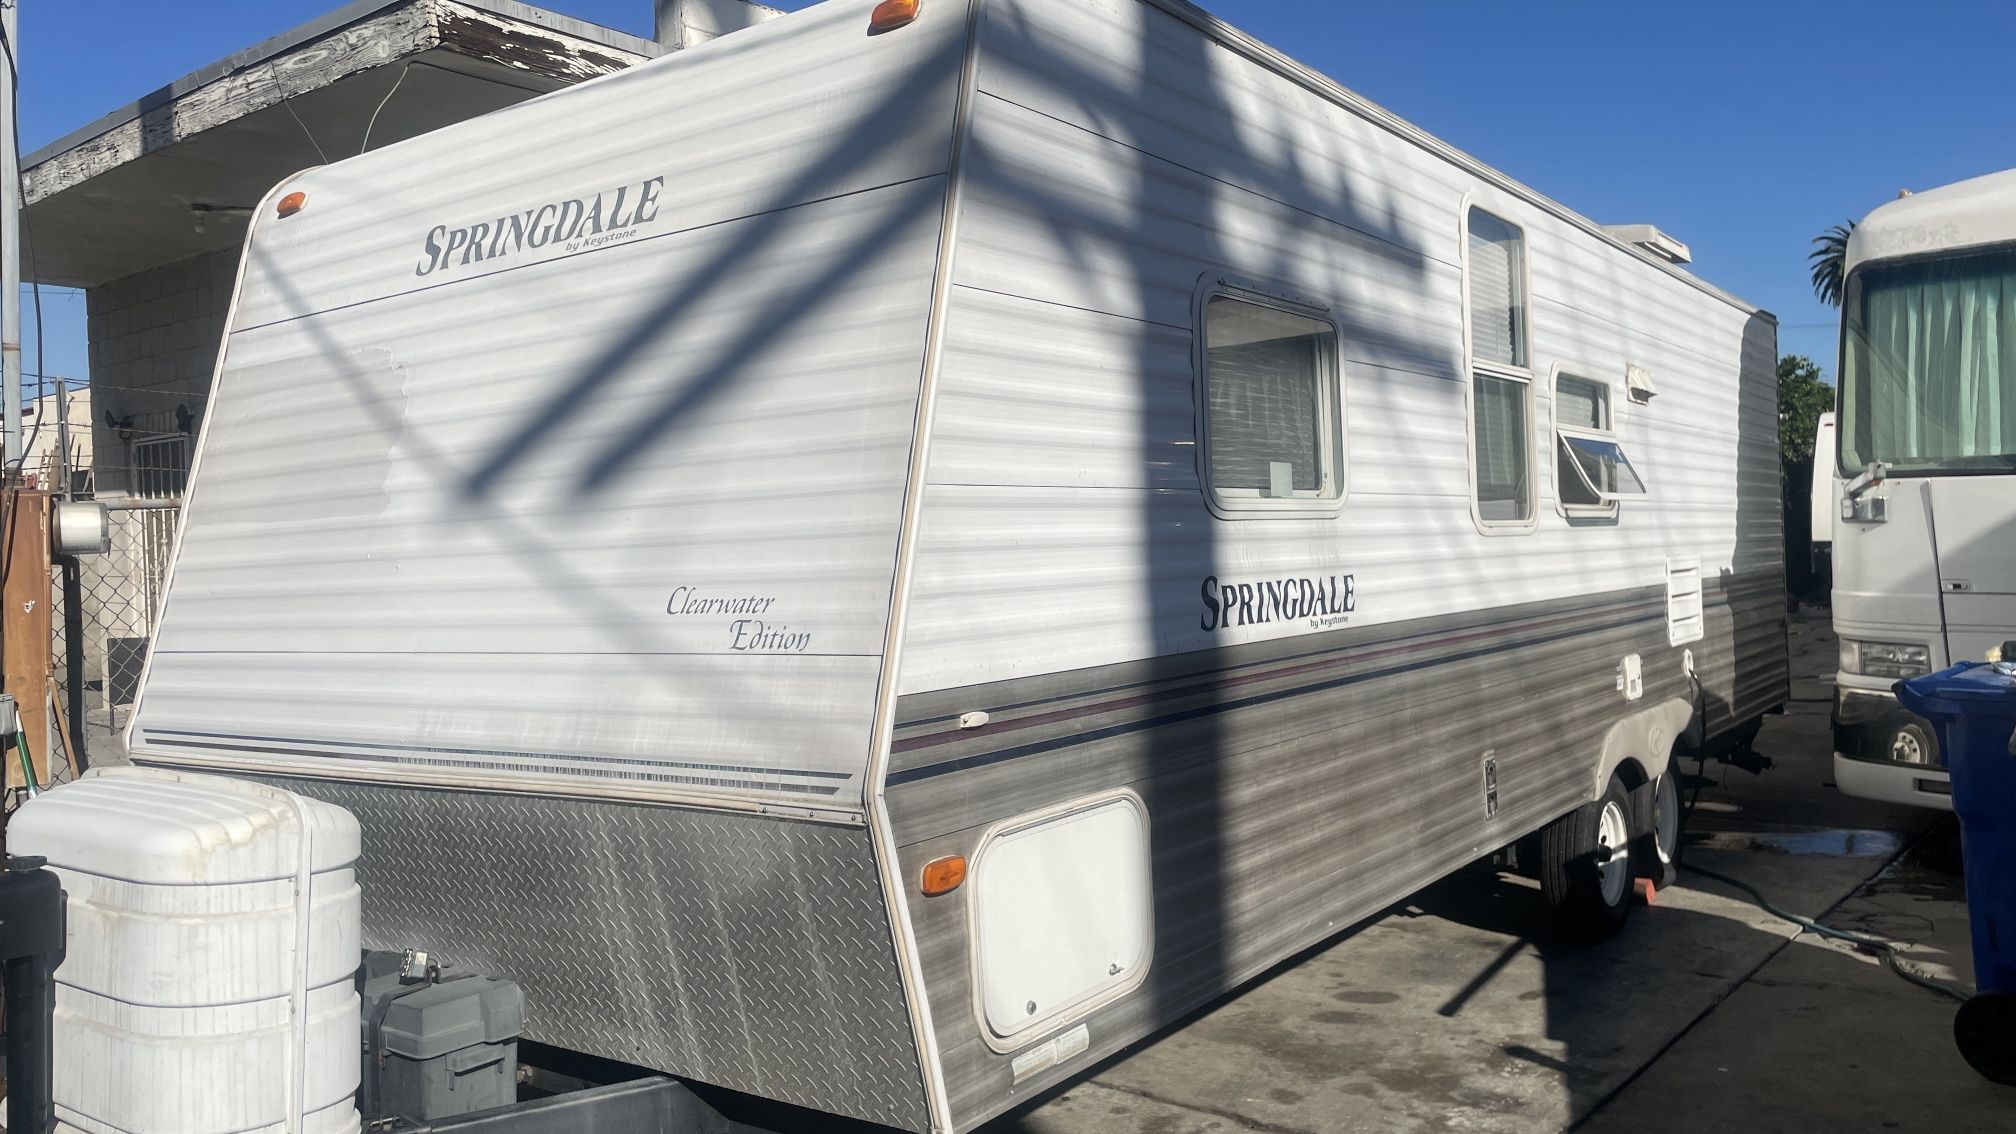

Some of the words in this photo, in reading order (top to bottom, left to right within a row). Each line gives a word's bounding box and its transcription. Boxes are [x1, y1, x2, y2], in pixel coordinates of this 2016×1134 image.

[415, 175, 664, 277] SPRINGDALE
[565, 241, 580, 253] by
[582, 229, 637, 248] Keystone
[666, 586, 776, 615] Clearwater
[1200, 574, 1356, 632] SPRINGDALE
[728, 619, 811, 652] Edition
[1310, 618, 1319, 629] by
[1320, 615, 1349, 628] Keystone
